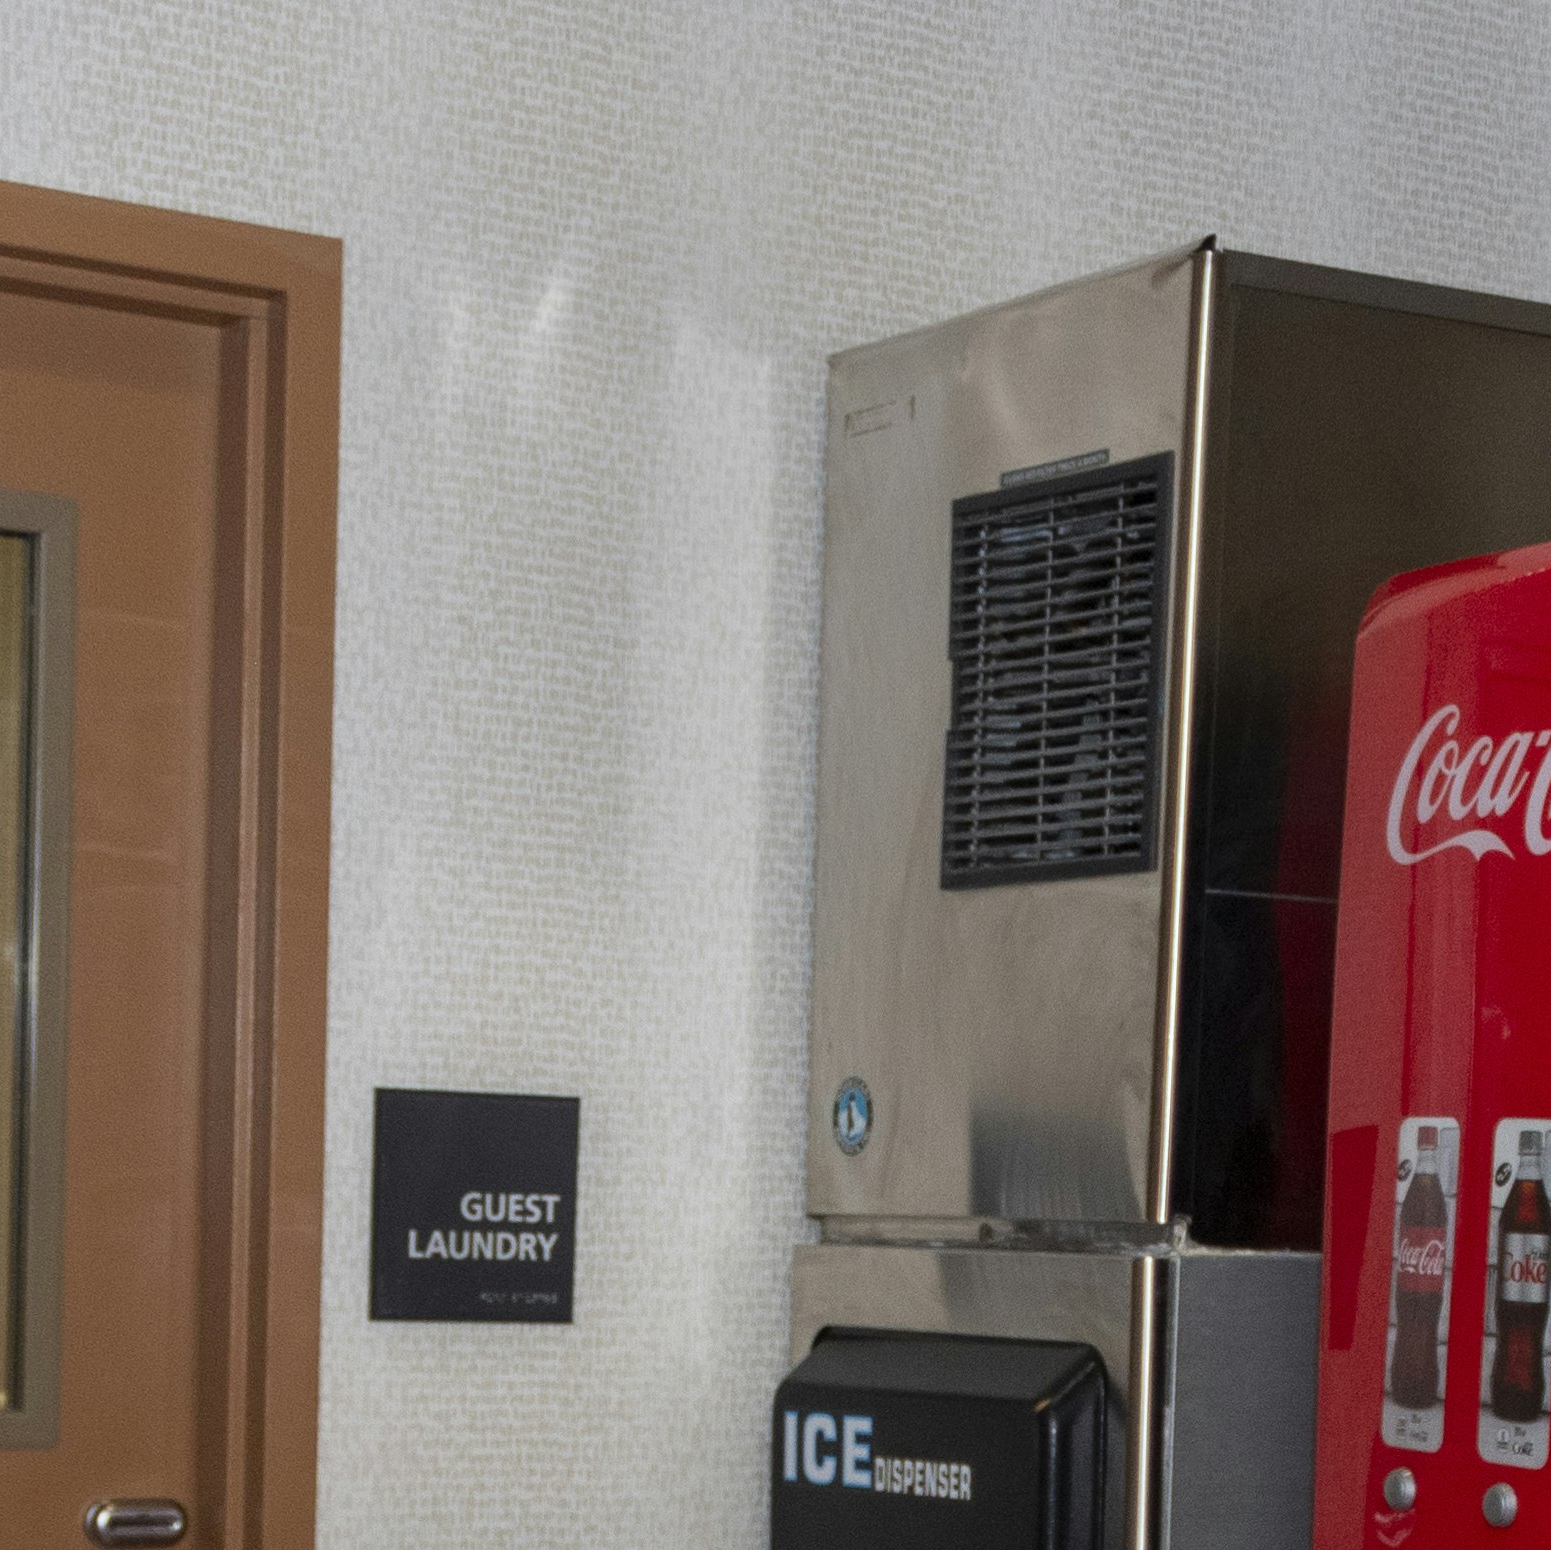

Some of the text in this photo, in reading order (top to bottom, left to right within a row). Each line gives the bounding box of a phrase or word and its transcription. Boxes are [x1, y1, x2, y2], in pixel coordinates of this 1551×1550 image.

[459, 1191, 562, 1224] GUEST
[407, 1229, 559, 1262] LAUNDRY
[782, 1409, 972, 1501] ICE DISPENSER
